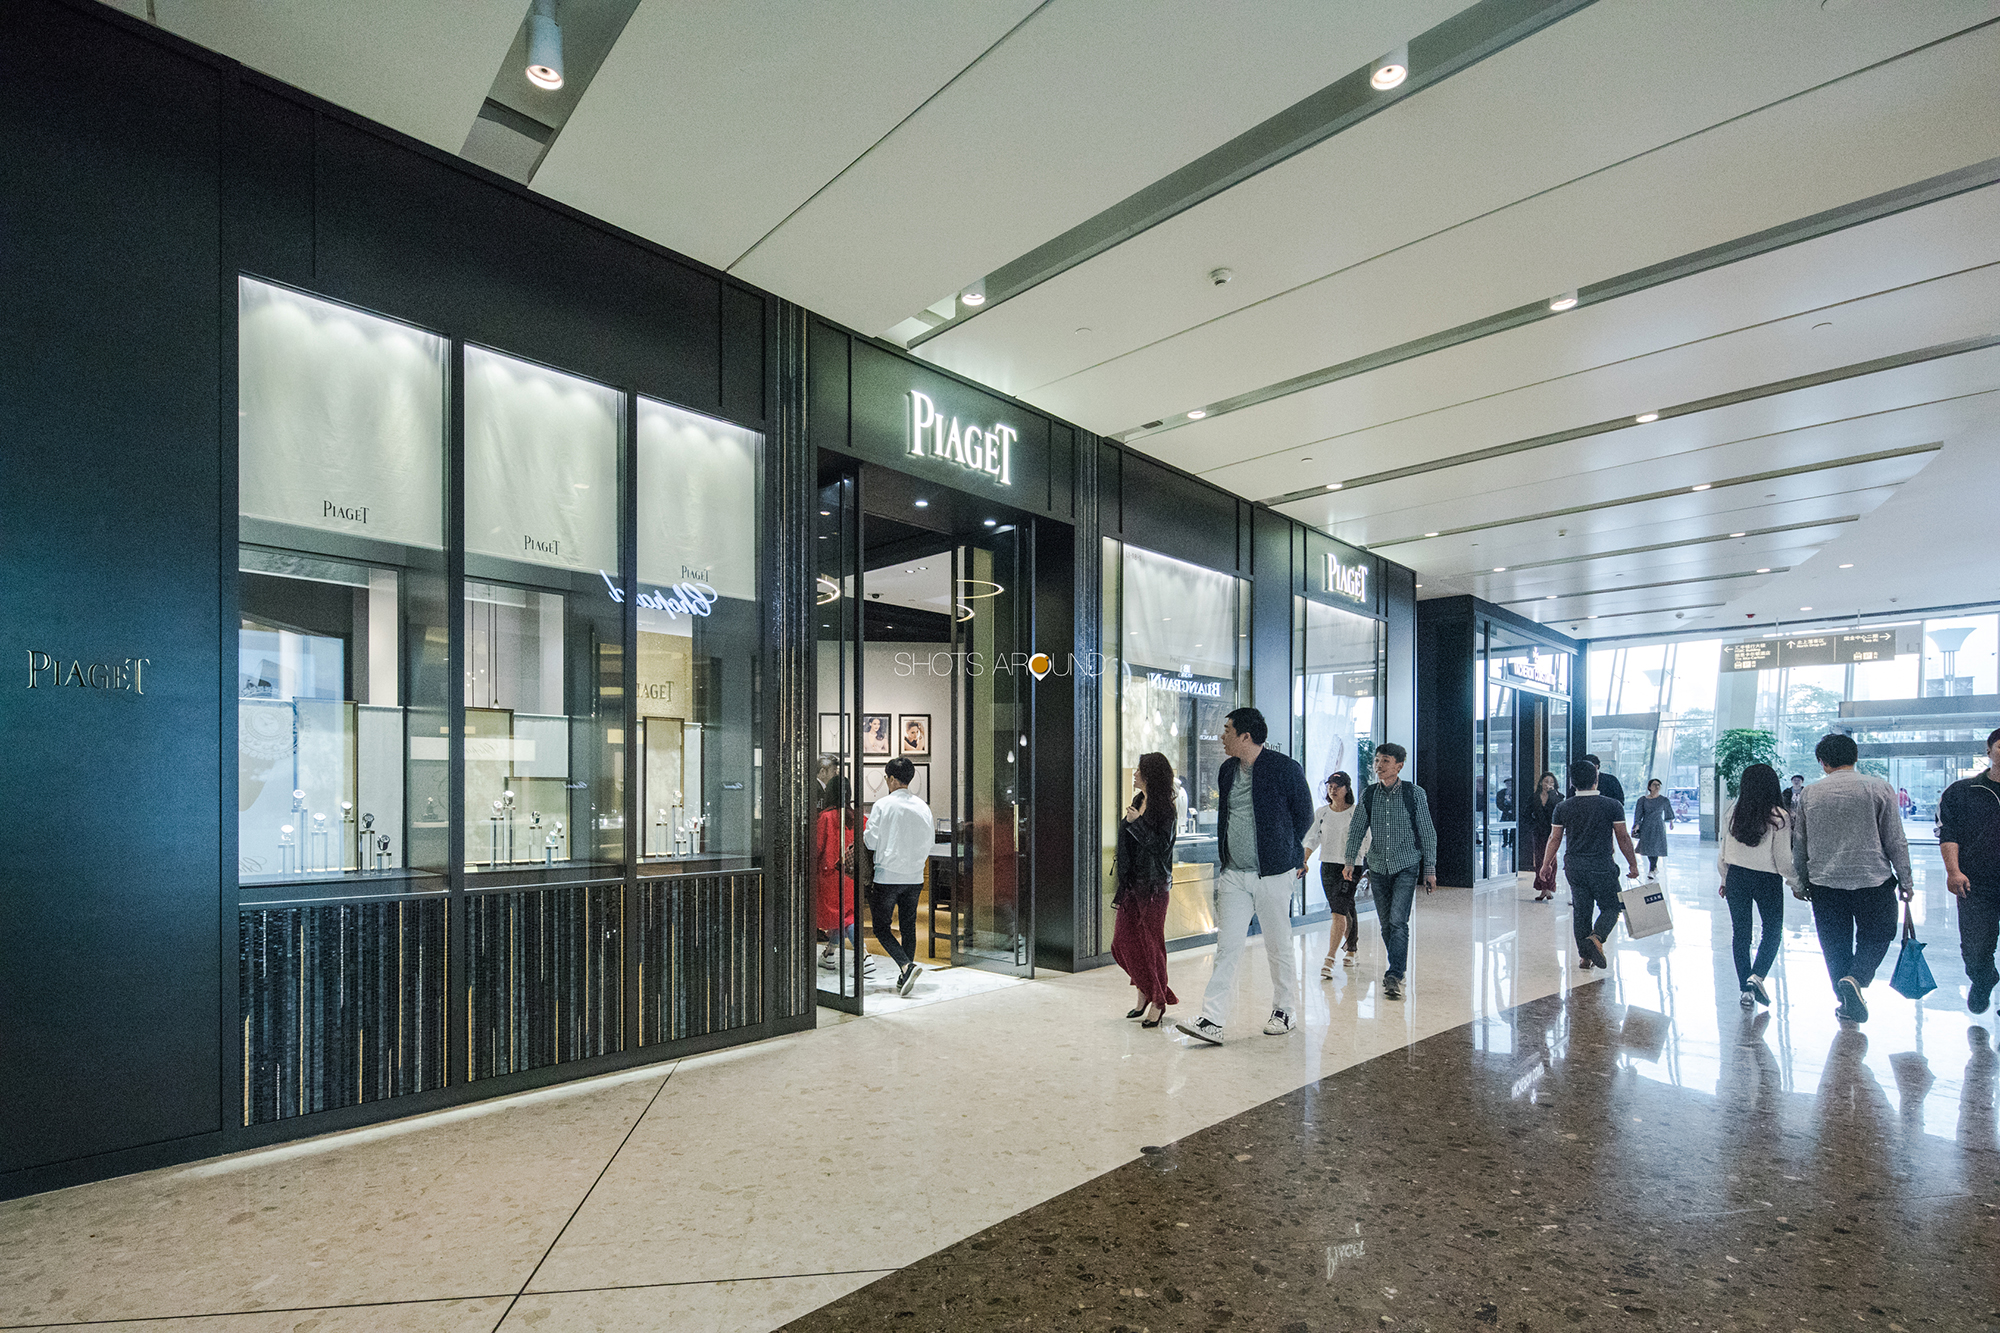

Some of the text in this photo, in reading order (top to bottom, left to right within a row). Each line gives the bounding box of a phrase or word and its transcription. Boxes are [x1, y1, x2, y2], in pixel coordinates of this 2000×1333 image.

[910, 389, 1018, 485] PIAGET
[323, 499, 370, 524] PIAGET
[524, 534, 561, 555] PIAGET
[681, 565, 710, 582] PIAGET
[1327, 552, 1369, 603] PIAGET
[26, 649, 151, 695] PIAGET
